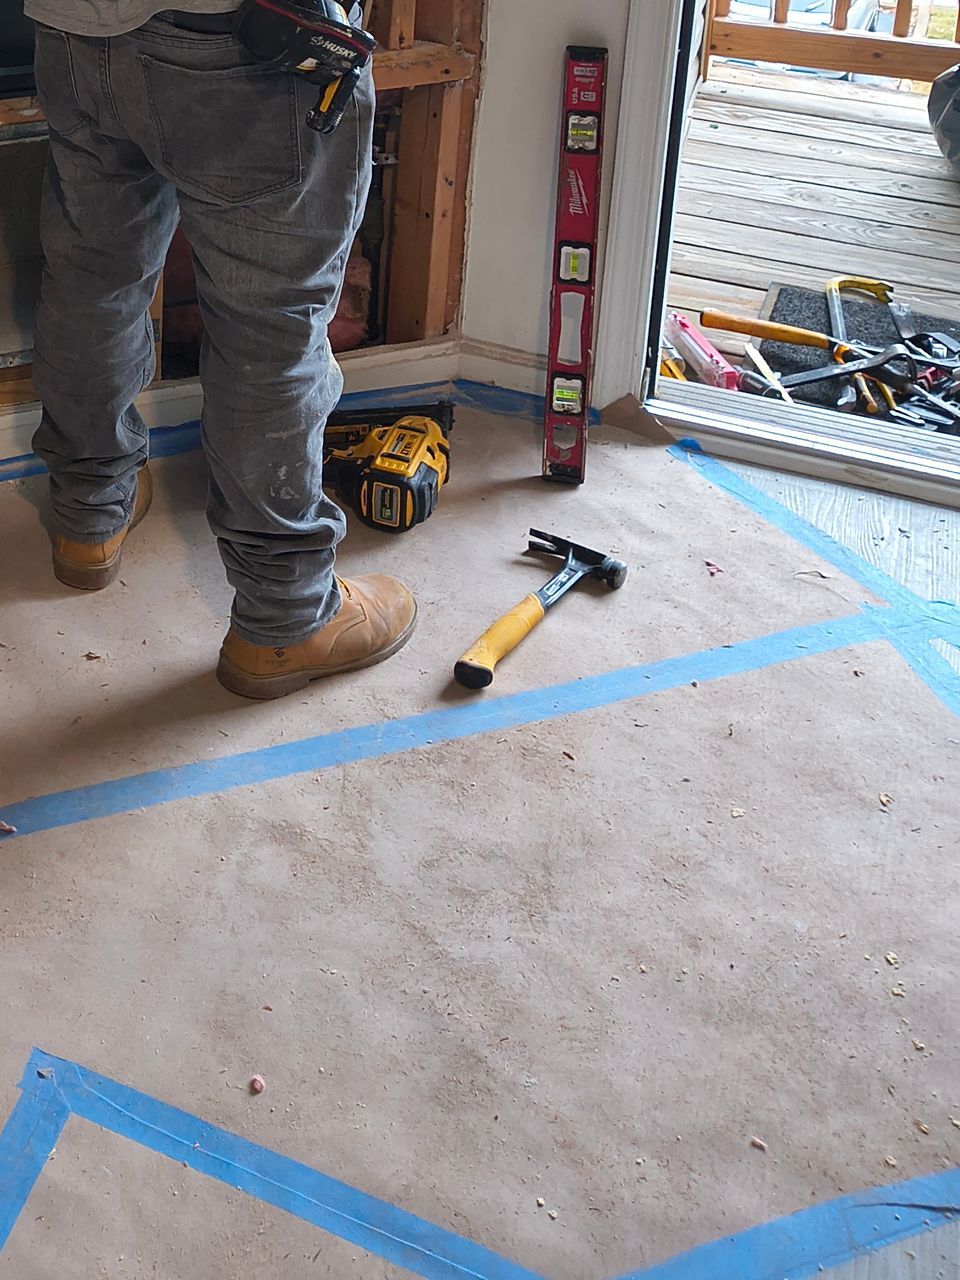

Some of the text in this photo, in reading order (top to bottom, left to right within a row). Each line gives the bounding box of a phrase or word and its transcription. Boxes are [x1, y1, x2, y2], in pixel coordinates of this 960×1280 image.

[321, 40, 357, 59] HUSKY
[571, 86, 580, 104] USA
[566, 168, 584, 217] Milwaukee
